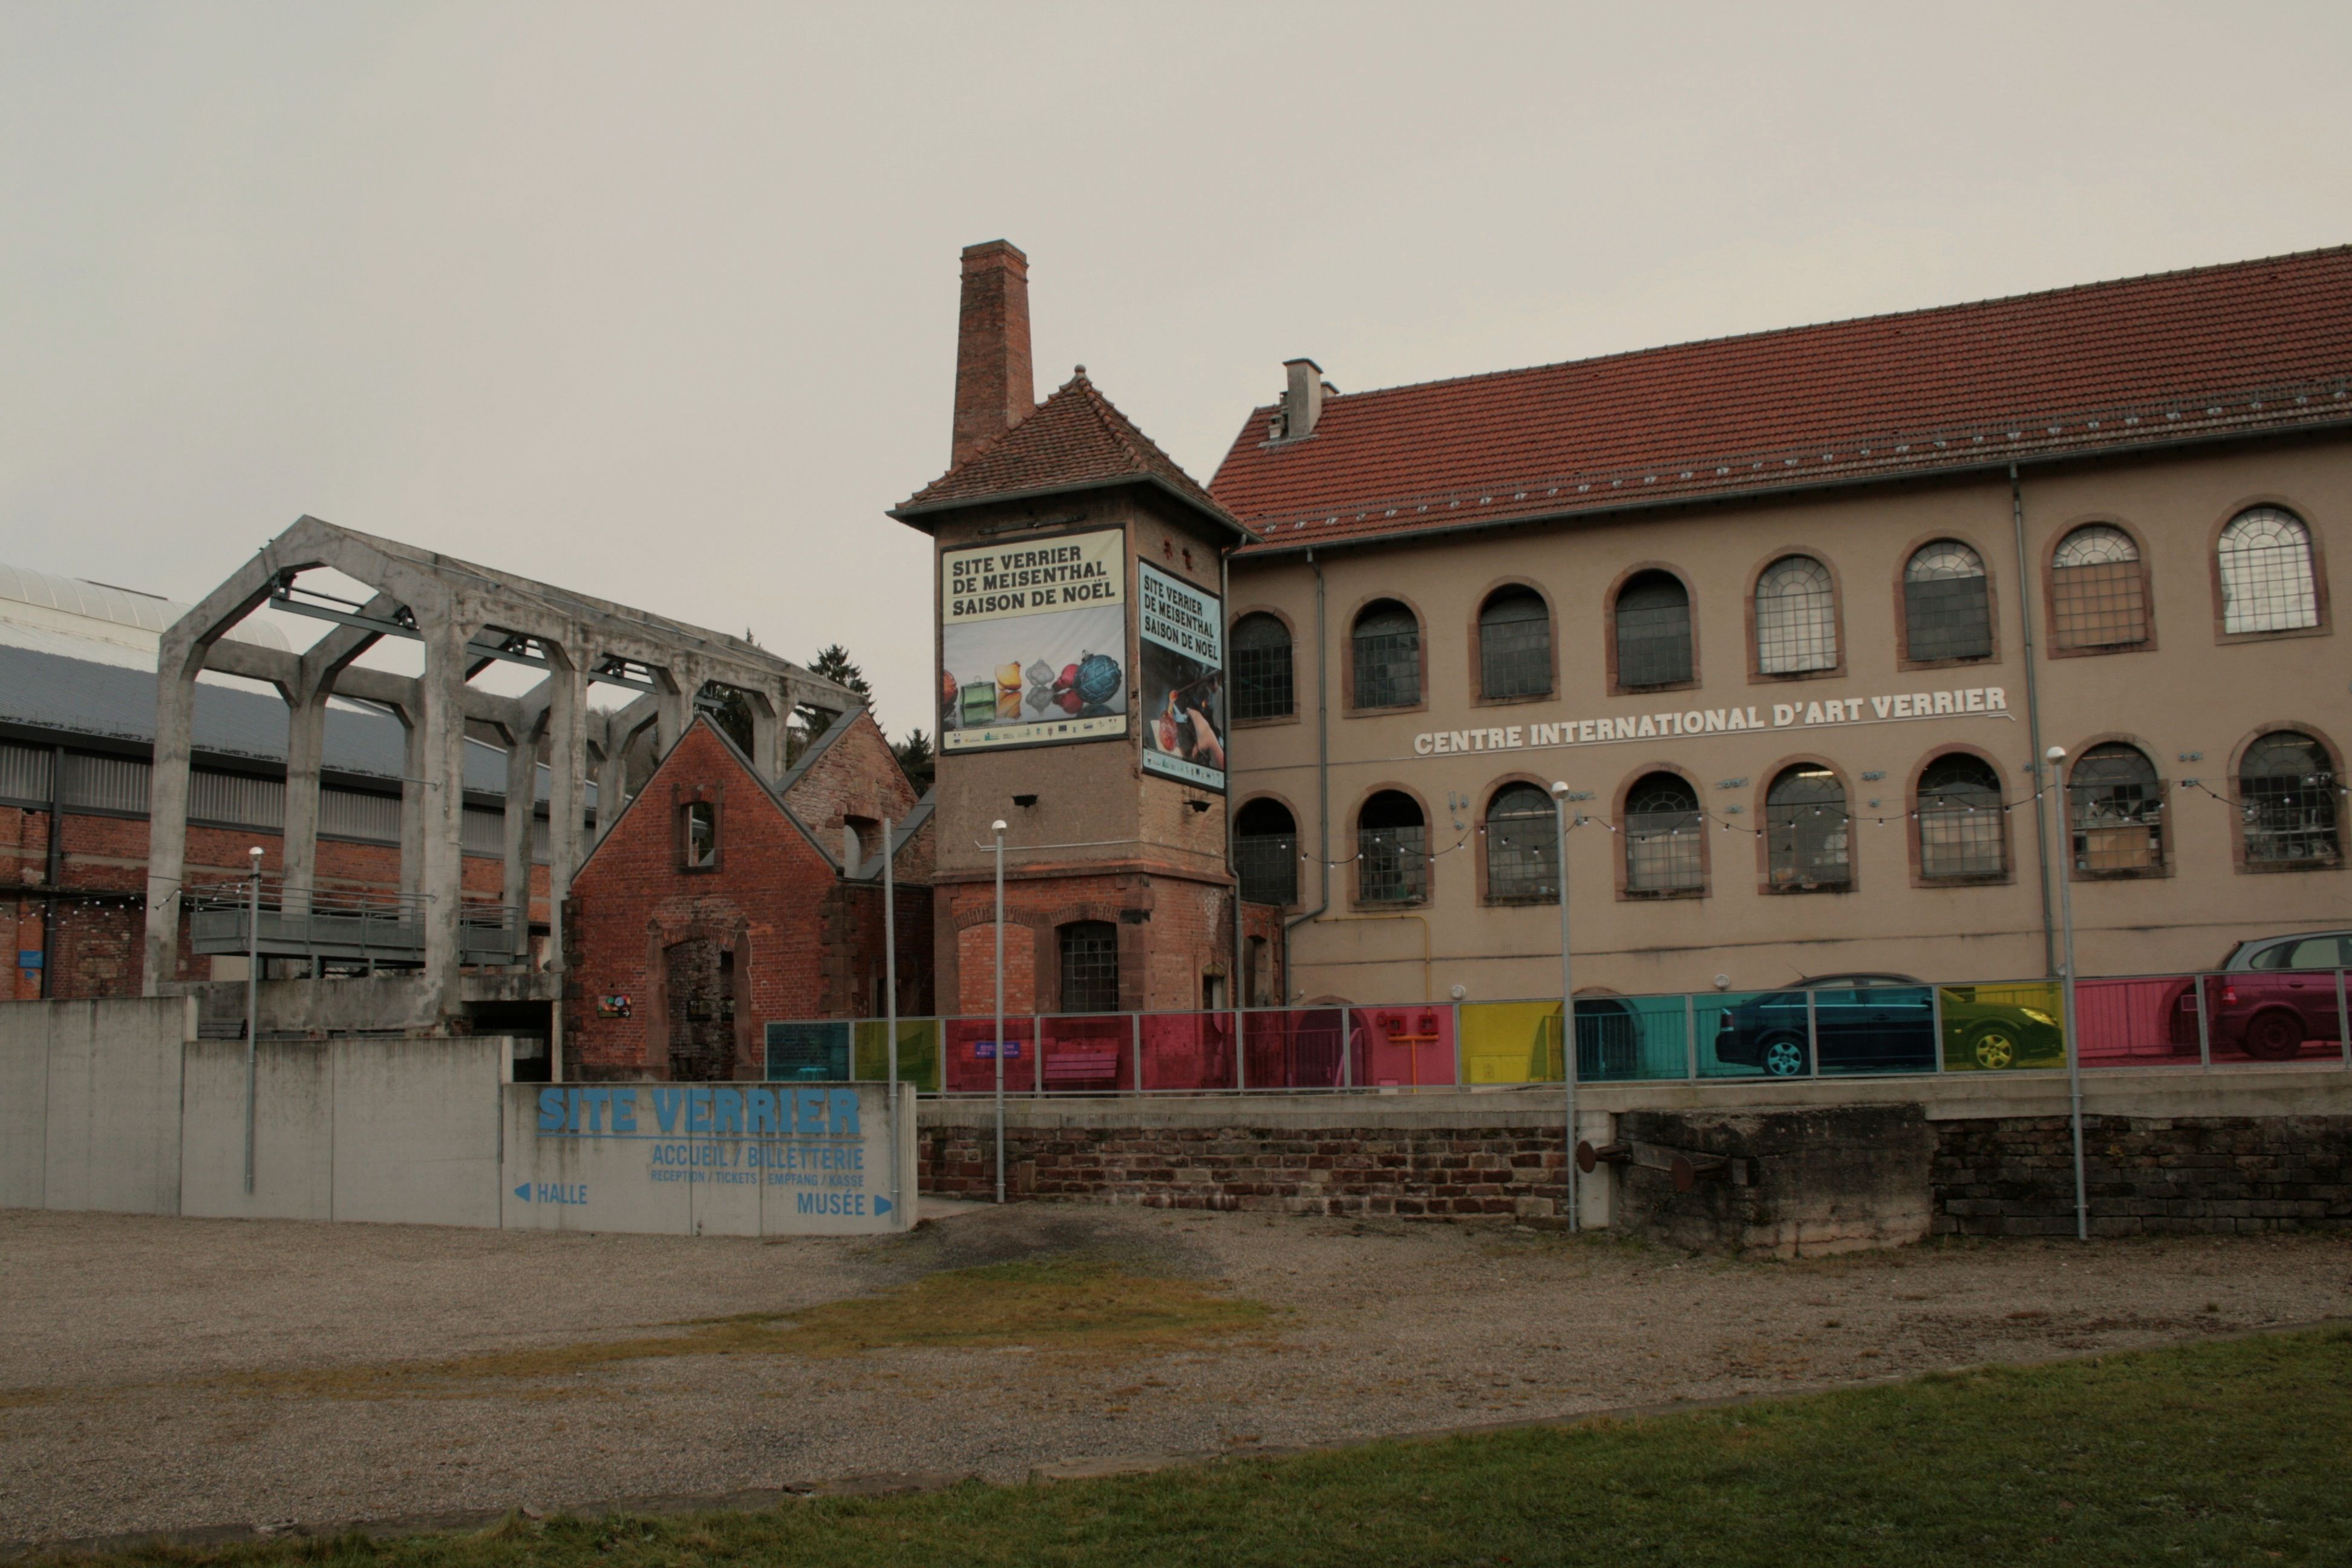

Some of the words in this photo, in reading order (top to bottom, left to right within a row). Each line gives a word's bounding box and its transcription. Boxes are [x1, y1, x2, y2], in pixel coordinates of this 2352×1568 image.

[953, 557, 994, 577] SITE
[1001, 546, 1081, 570] VERRIER
[953, 577, 977, 595] DE
[983, 561, 1106, 591] MEISENTHAL
[953, 592, 1025, 616] SAISON
[1031, 589, 1056, 607] DE
[1063, 578, 1115, 603] NOËL
[1144, 575, 1164, 598] SITE
[1166, 586, 1203, 617] VERRIER
[1145, 593, 1157, 613] DE
[1158, 599, 1214, 639] MEISENTHAL
[1145, 615, 1179, 644] SAISON
[1181, 632, 1193, 650] DE
[1414, 726, 1523, 755] CENTRE
[1530, 707, 1765, 746] INTERNATIONAL
[1772, 697, 1864, 727] D'ART
[1870, 687, 2007, 719] VERRIER
[538, 1087, 637, 1131] SITE
[652, 1087, 861, 1134] VERRIER
[652, 1144, 728, 1166] ACCUEIL
[748, 1146, 864, 1170] BILLETTERIE
[537, 1183, 588, 1205] HALLE
[652, 1169, 705, 1183] RECEPTION
[716, 1171, 757, 1185] TICKETS
[769, 1173, 818, 1186] EMPFANG
[829, 1174, 864, 1187] KASSE
[797, 1189, 866, 1216] MUSÉE
